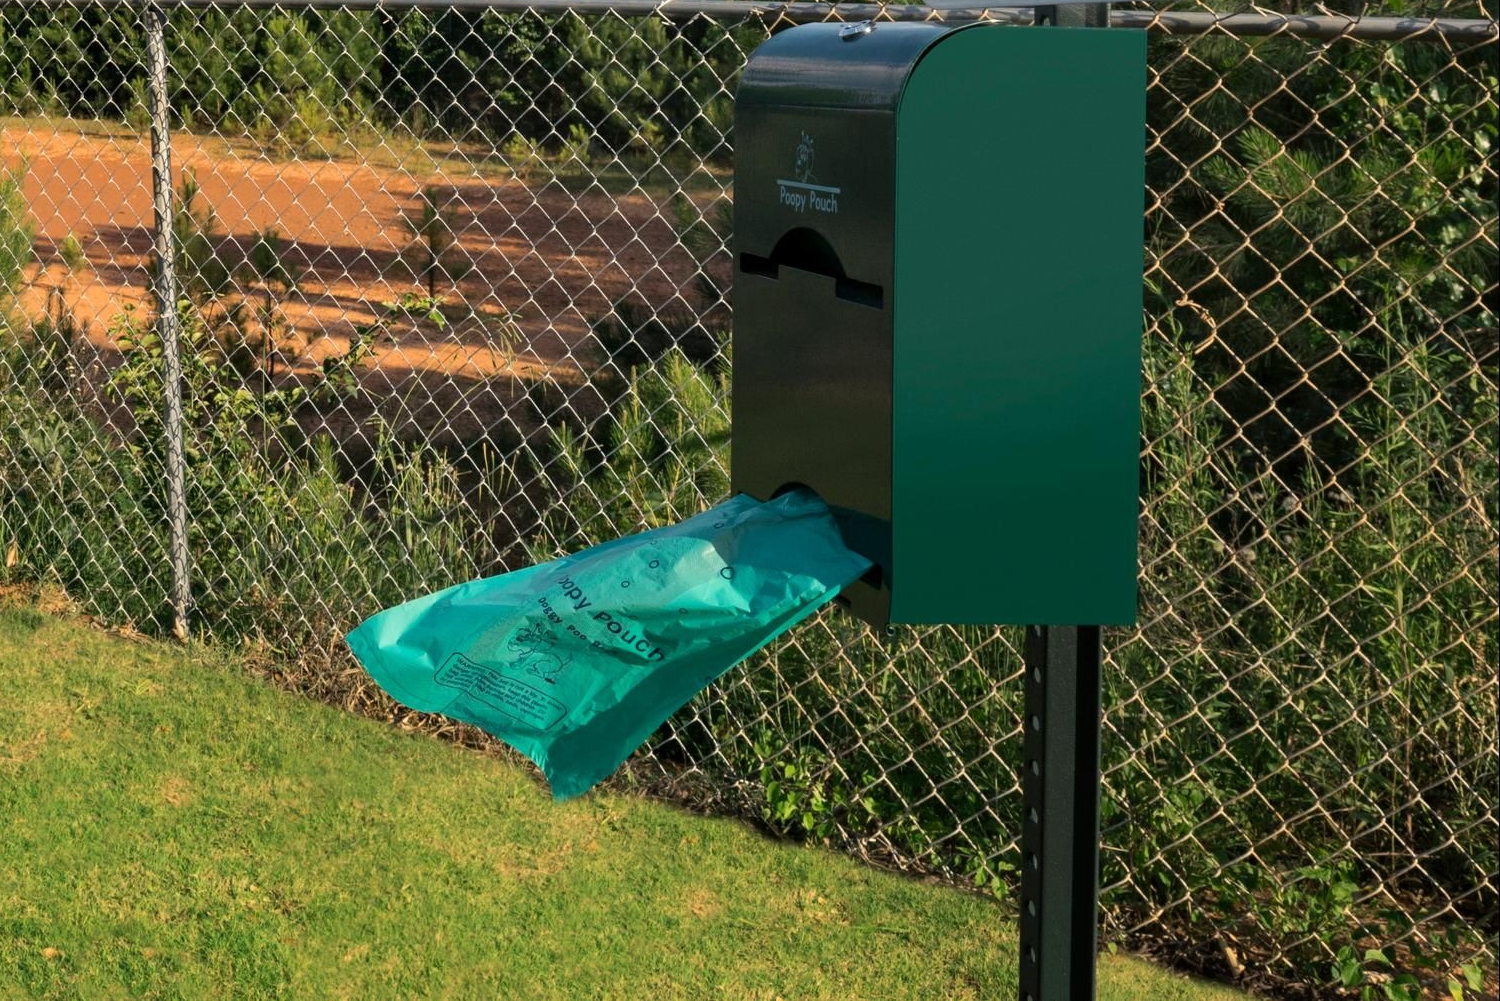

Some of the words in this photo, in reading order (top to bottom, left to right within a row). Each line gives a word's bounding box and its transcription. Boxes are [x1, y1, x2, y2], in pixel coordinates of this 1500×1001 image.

[780, 185, 806, 213] Poopy
[810, 190, 838, 213] Pouch
[567, 624, 587, 641] Poo
